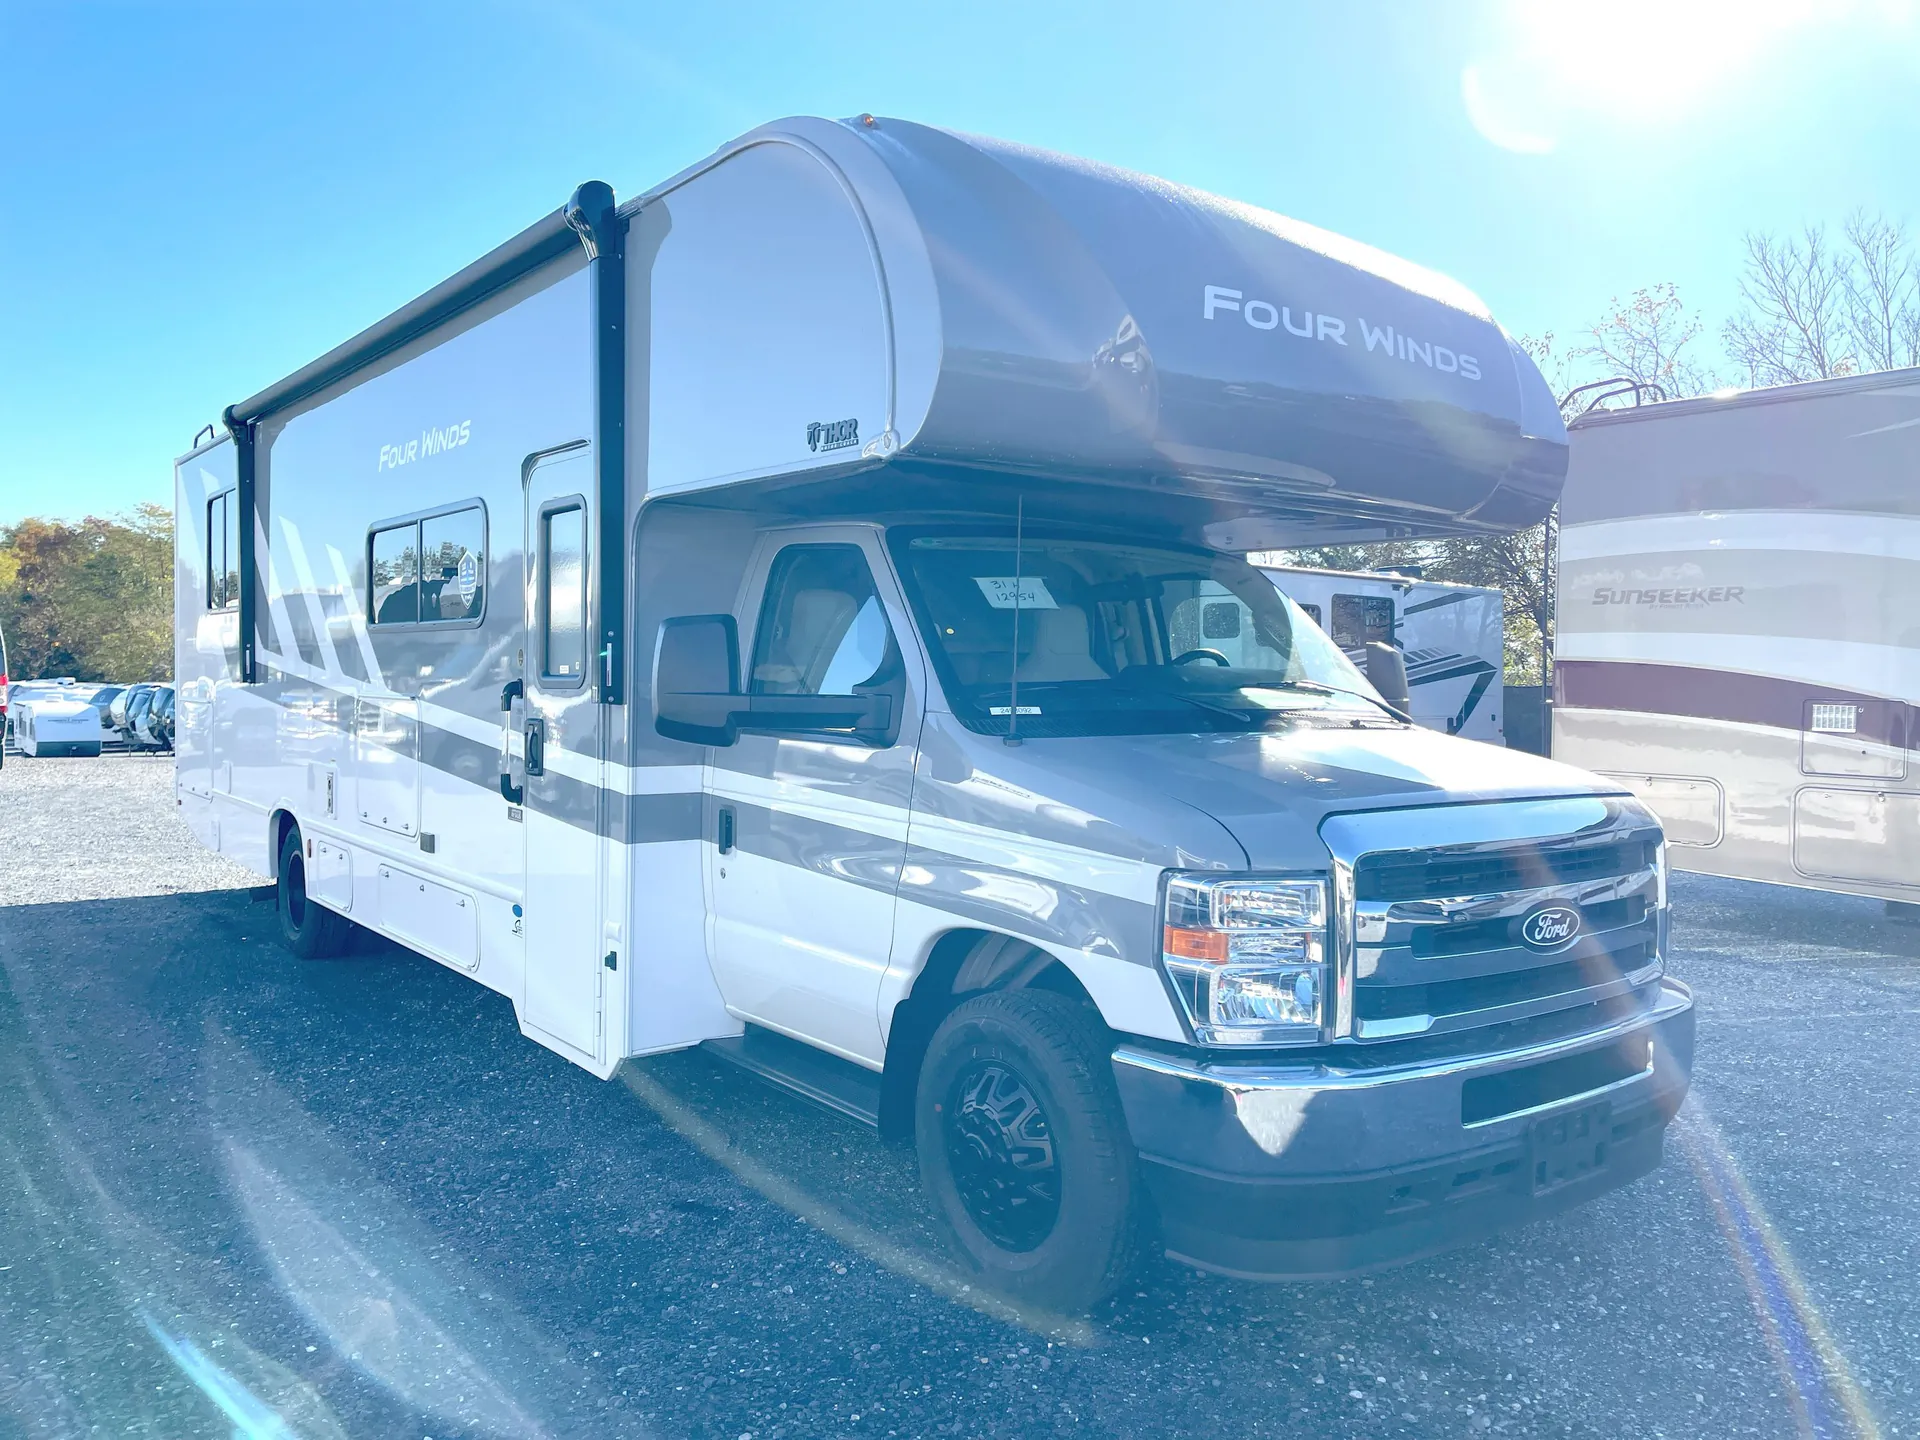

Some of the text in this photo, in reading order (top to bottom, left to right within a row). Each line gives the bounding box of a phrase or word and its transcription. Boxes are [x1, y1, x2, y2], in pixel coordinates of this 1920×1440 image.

[1203, 284, 1482, 381] FOUR WINDS
[821, 418, 859, 445] THOR
[378, 419, 472, 473] FOUR WINDS
[1592, 586, 1745, 606] SUNSEEKER
[1534, 913, 1571, 941] Ford
